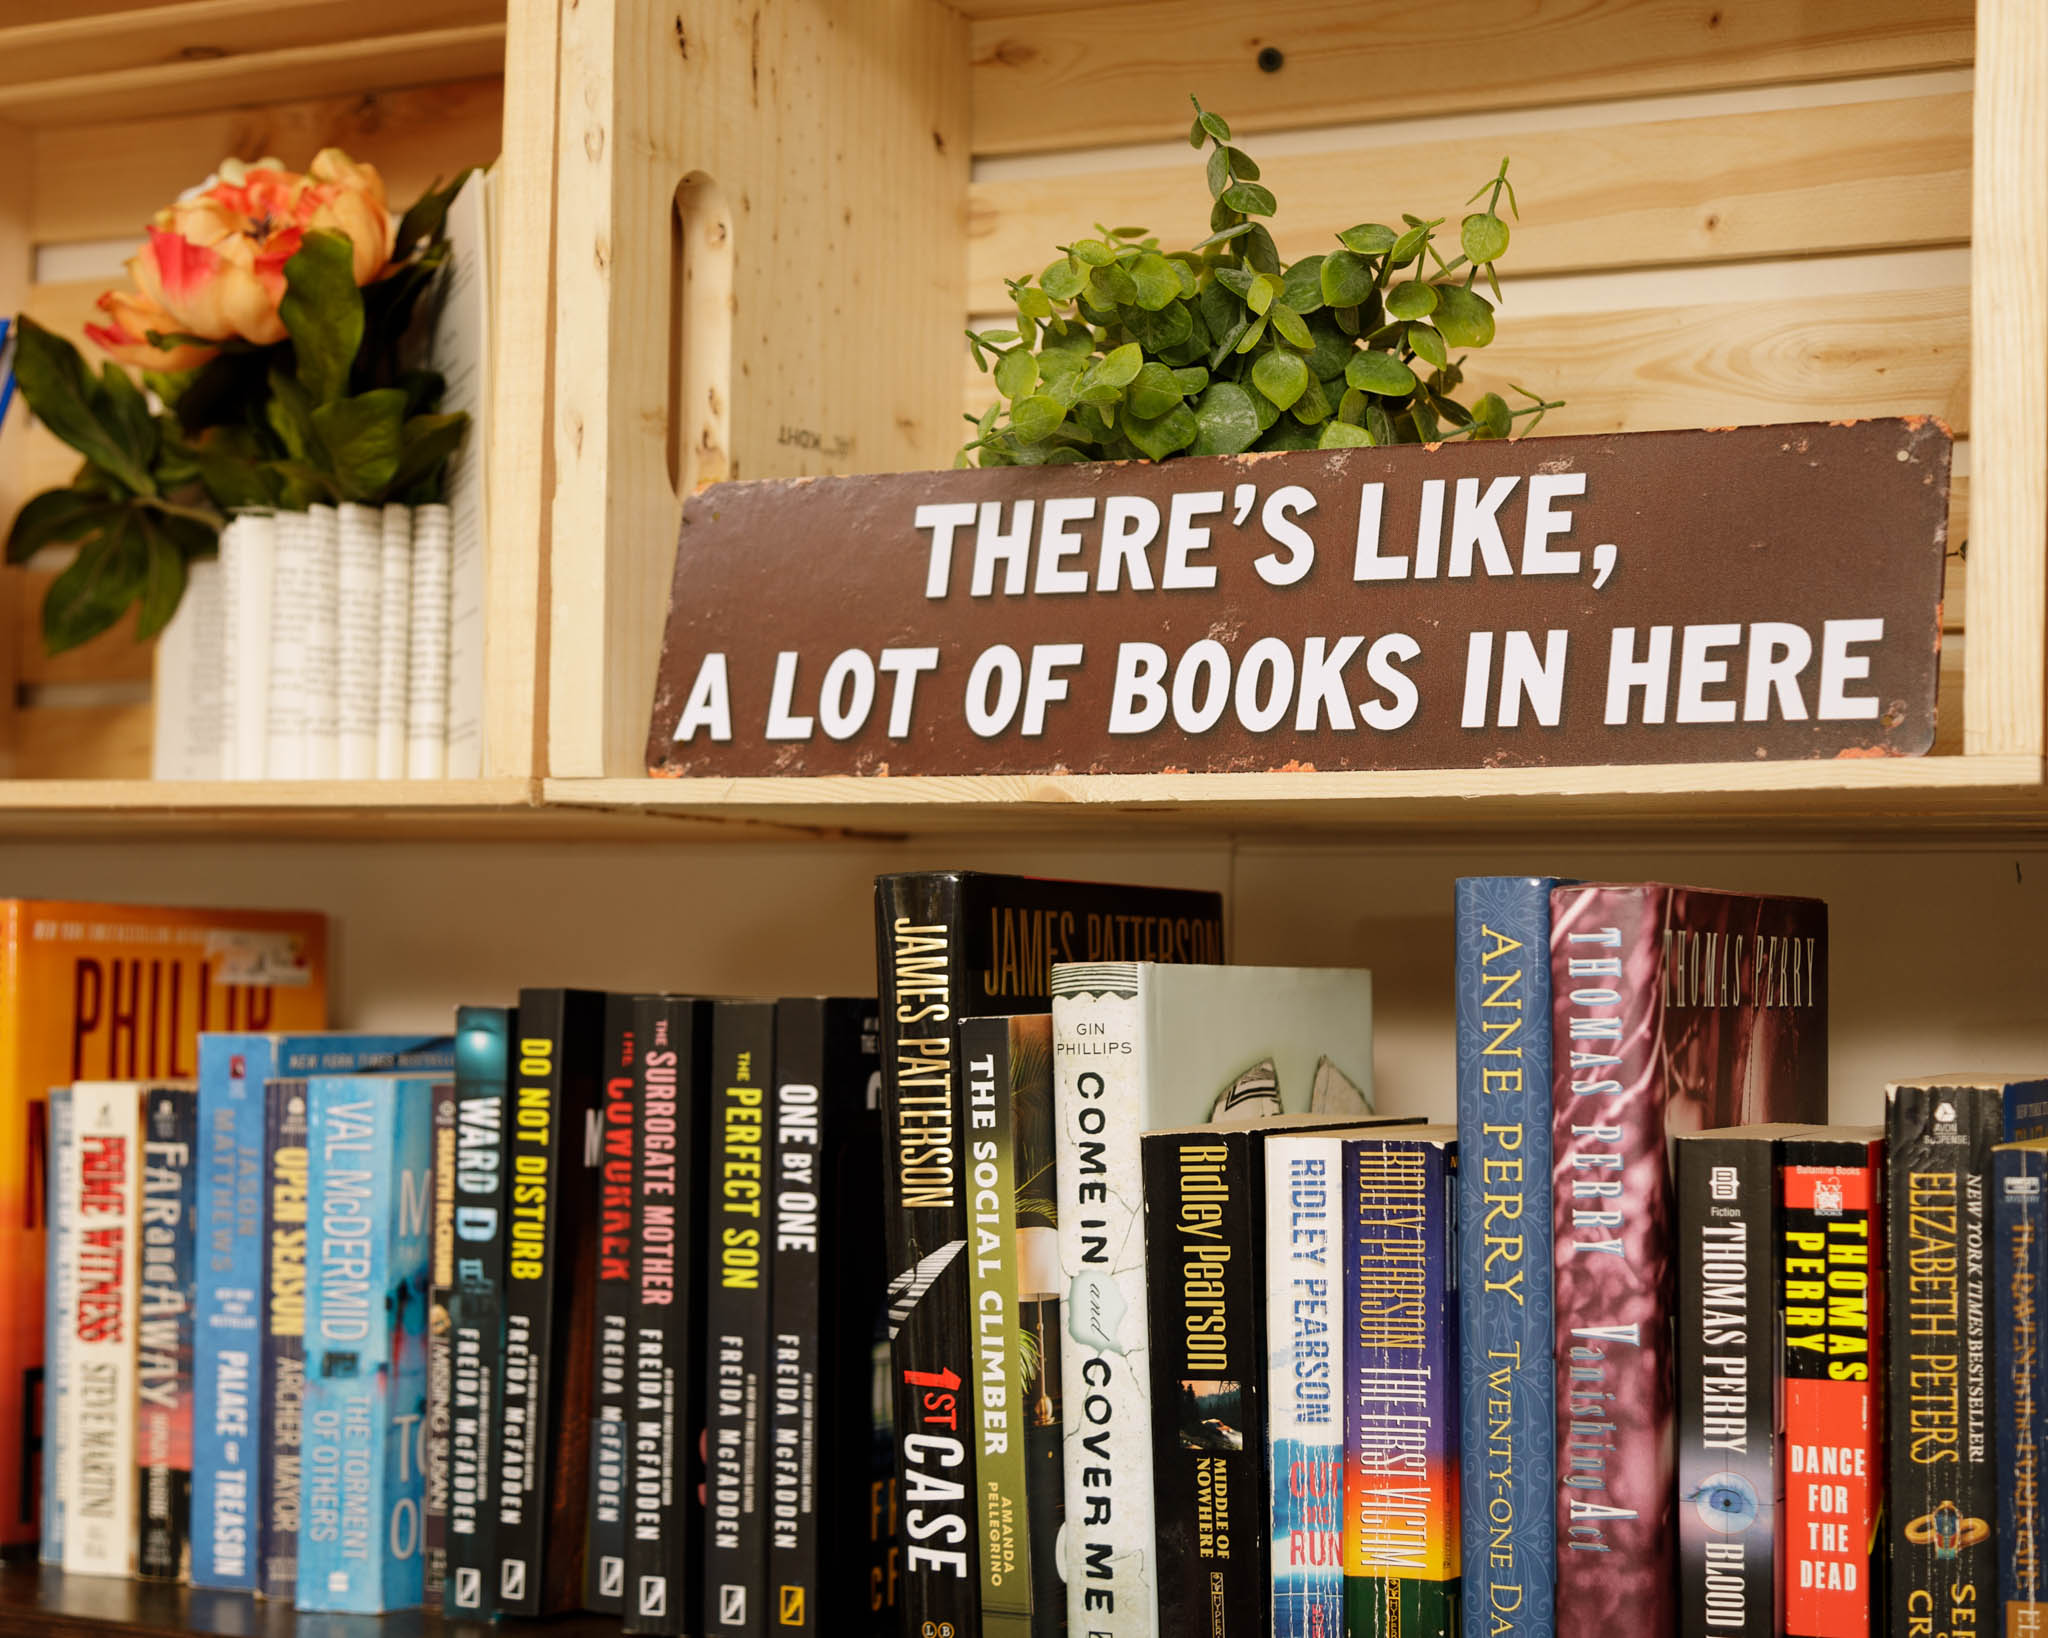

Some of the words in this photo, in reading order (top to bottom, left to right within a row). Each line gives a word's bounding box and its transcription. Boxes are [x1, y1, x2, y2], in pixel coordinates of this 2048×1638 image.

[912, 482, 1317, 599] THERE'S
[1353, 471, 1619, 591] LIKE,
[671, 651, 732, 742] A
[764, 644, 940, 740] LOT
[965, 641, 1084, 738] OF
[1107, 631, 1421, 734] BOOKS
[1460, 627, 1569, 727] IN
[1603, 617, 1884, 725] HERE
[894, 917, 950, 1023] JAMES
[984, 907, 1075, 998] JAMES
[1086, 913, 1223, 964] PATTERSON
[1663, 929, 1744, 1008] THOMAS
[1754, 936, 1815, 1008] PERRY
[654, 1019, 668, 1048] THE
[1056, 1042, 1132, 1056] PHILLIPS
[1076, 1022, 1106, 1035] GIN
[1481, 924, 1523, 1095] ANNE
[1568, 927, 1622, 1097] THOMAS
[519, 1038, 553, 1077] DO
[737, 1051, 751, 1082] THE
[969, 1053, 997, 1129] THE
[324, 1100, 375, 1161] VAL
[457, 1096, 502, 1194] WARD
[516, 1086, 551, 1146] NOT
[643, 1050, 677, 1197] SURROGATE
[722, 1087, 763, 1218] PERFECT
[778, 1083, 819, 1146] ONE
[897, 1037, 954, 1208] PATTERSON
[1076, 1071, 1106, 1205] COME
[144, 1141, 190, 1224] FAR
[211, 1108, 237, 1272] MATTHEWS
[238, 1146, 260, 1236] JASON
[272, 1147, 308, 1223] OPEN
[782, 1153, 812, 1185] BY
[972, 1140, 1000, 1279] SOCIAL
[1176, 1145, 1229, 1239] Ridley
[1291, 1159, 1327, 1264] RIDLEY
[1359, 1150, 1426, 1230] RIDLEY
[1571, 1124, 1625, 1258] PERRY
[1710, 1206, 1741, 1218] Fiction
[1836, 1166, 1861, 1176] Books
[1966, 1173, 1983, 1217] NEW
[456, 1206, 499, 1241] D
[510, 1155, 548, 1280] DISTURB
[641, 1204, 675, 1306] MOTHER
[721, 1227, 760, 1290] SON
[777, 1191, 818, 1254] ONE
[1080, 1219, 1109, 1263] IN
[1483, 1123, 1524, 1306] PERRY
[1909, 1172, 1958, 1337] ELIZABETH
[1967, 1221, 1984, 1277] YORK
[77, 1226, 124, 1344] WITNESS
[270, 1228, 308, 1336] SEASON
[1089, 1282, 1111, 1342] and
[1183, 1245, 1231, 1370] Pearson
[1359, 1238, 1426, 1350] PEARSON
[1702, 1221, 1747, 1347] THOMAS
[1785, 1232, 1825, 1353] PERRY
[1828, 1219, 1869, 1381] THOMAS
[1967, 1280, 1984, 1336] TIMES
[139, 1284, 187, 1409] AWAY
[454, 1327, 482, 1408] FREIDA
[505, 1314, 531, 1396] FREIDA
[601, 1314, 626, 1395] FREIDA
[637, 1328, 663, 1411] FREIDA
[719, 1335, 744, 1417] FREIDA
[775, 1334, 800, 1416] FREIDA
[979, 1290, 1009, 1456] CLIMBER
[1294, 1279, 1331, 1423] PEARSON
[1361, 1365, 1431, 1408] THE
[215, 1350, 249, 1438] PALACE
[273, 1356, 305, 1448] ARCHER
[311, 1409, 341, 1442] OF
[344, 1395, 372, 1441] THE
[1563, 1323, 1640, 1490] Vanishing
[1702, 1355, 1747, 1454] PERRY
[1910, 1354, 1960, 1465] PETERS
[1967, 1337, 1985, 1464] BESTSELLER!
[452, 1418, 480, 1535] McFADDEN
[500, 1406, 526, 1525] McFADDEN
[597, 1405, 624, 1523] McFADDEN
[635, 1420, 662, 1541] McFADDEN
[1082, 1357, 1112, 1527] COVER
[1290, 1461, 1342, 1498] CUT
[1361, 1414, 1431, 1481] FIRST
[1487, 1341, 1522, 1569] TWENTY-ONE
[1791, 1445, 1866, 1477] DANCE
[212, 1469, 248, 1577] TREASON
[272, 1454, 302, 1533] MAYOR
[309, 1446, 341, 1542] OTHERS
[342, 1448, 371, 1560] TORMENT
[715, 1428, 742, 1549] McFADDEN
[774, 1428, 799, 1549] McFADDEN
[904, 1432, 967, 1578] CASE
[1196, 1457, 1213, 1559] NOWHERE
[1213, 1457, 1229, 1531] MIDDLE
[1303, 1504, 1331, 1525] and
[1361, 1488, 1432, 1568] VICTIM
[1568, 1499, 1639, 1552] Act
[1808, 1485, 1849, 1515] FOR
[988, 1481, 1002, 1587] PELLEGRINO
[1001, 1496, 1016, 1574] AMANDA
[1216, 1535, 1230, 1560] OF
[1290, 1529, 1343, 1566] RUN
[1800, 1560, 1858, 1592] DEAD
[1808, 1522, 1849, 1553] THE
[1085, 1543, 1114, 1615] ME
[1705, 1542, 1745, 1628] BLOOD
